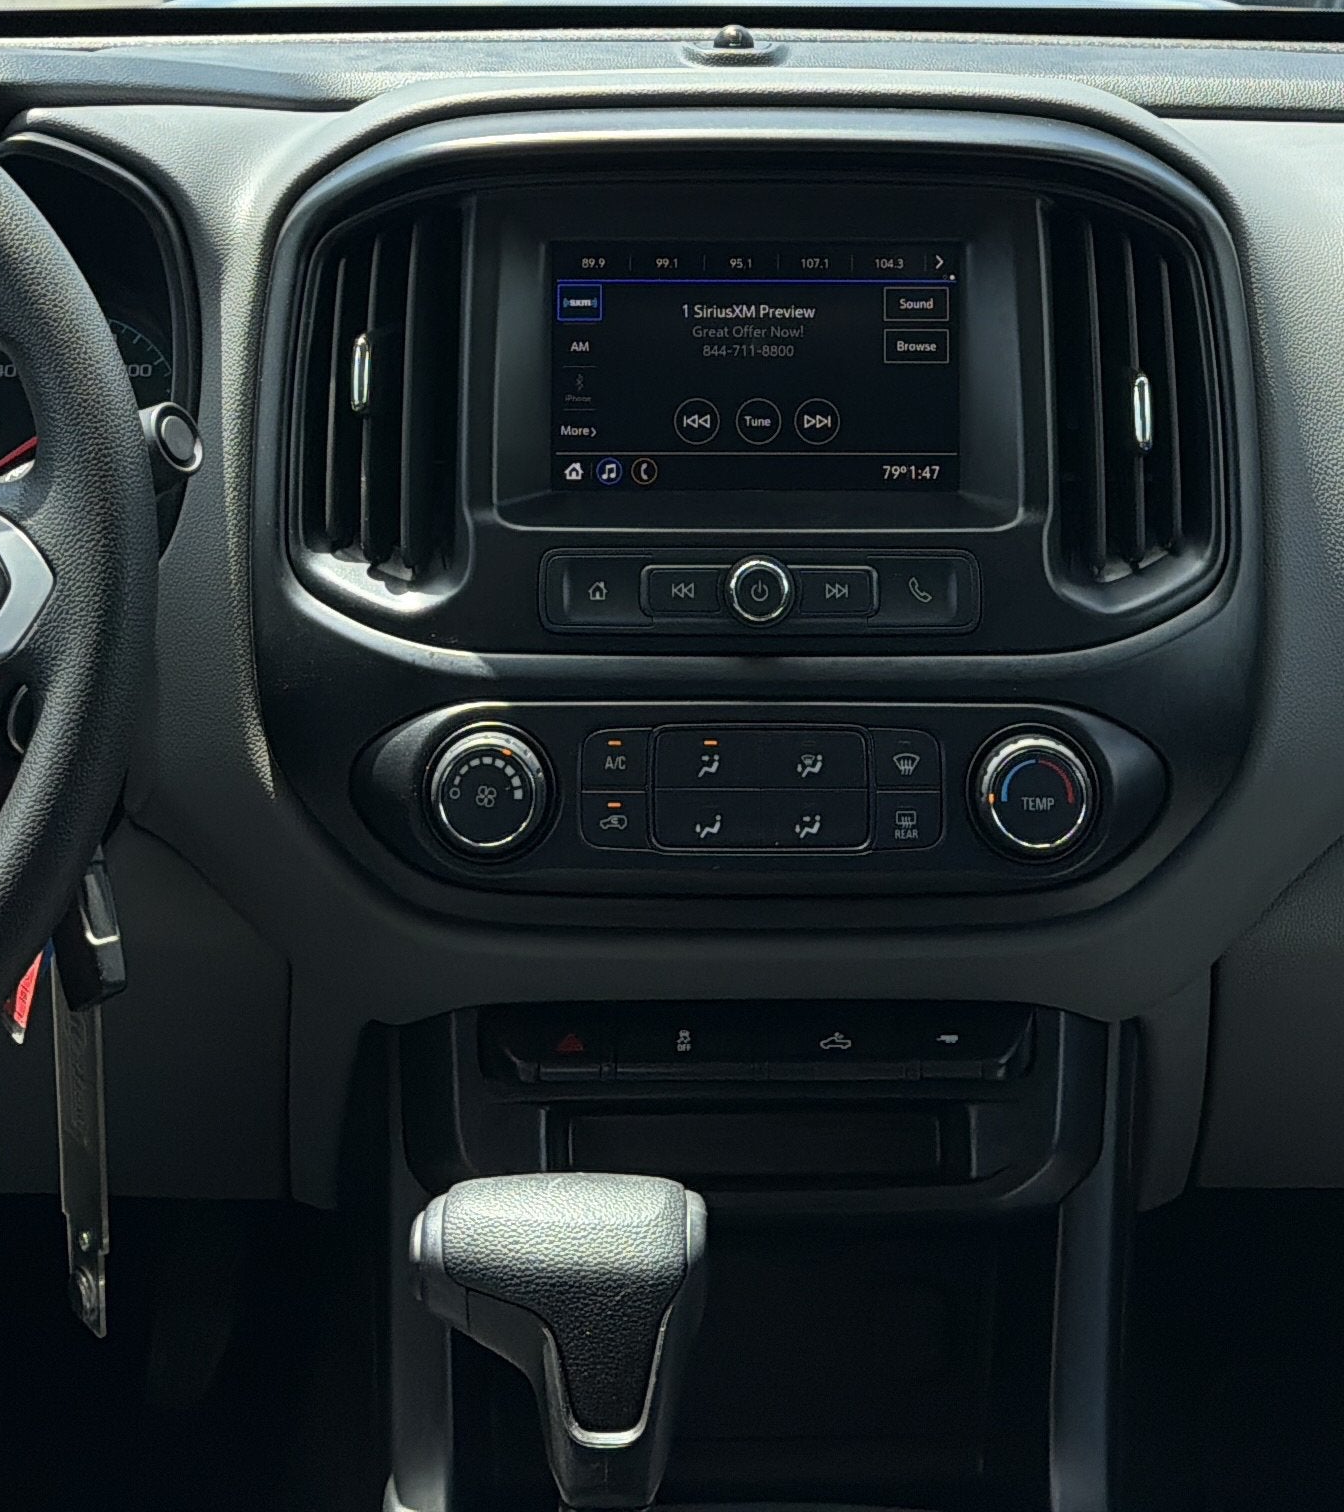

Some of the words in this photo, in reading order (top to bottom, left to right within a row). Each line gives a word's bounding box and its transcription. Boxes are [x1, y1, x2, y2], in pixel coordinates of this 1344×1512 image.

[581, 257, 606, 270] 89.9
[655, 257, 679, 270] 99.1
[729, 257, 753, 270] 95.1
[800, 257, 830, 270] 107.1
[874, 257, 904, 270] 104.3
[899, 298, 934, 311] Sound
[682, 305, 689, 319] 1
[693, 304, 756, 319] SiriusXM
[759, 304, 816, 319] Preview
[692, 325, 730, 339] Great
[733, 325, 767, 339] Offer
[771, 325, 805, 339] Now!
[570, 341, 590, 353] AM
[702, 345, 794, 358] 844-711-8800
[896, 340, 937, 352] Browse
[128, 363, 152, 378] 00
[744, 416, 772, 428] Tune
[560, 425, 590, 437] More
[604, 753, 627, 773] A/C
[1021, 796, 1055, 813] TEMP
[893, 828, 919, 841] REAR
[676, 1043, 692, 1052] OFF
